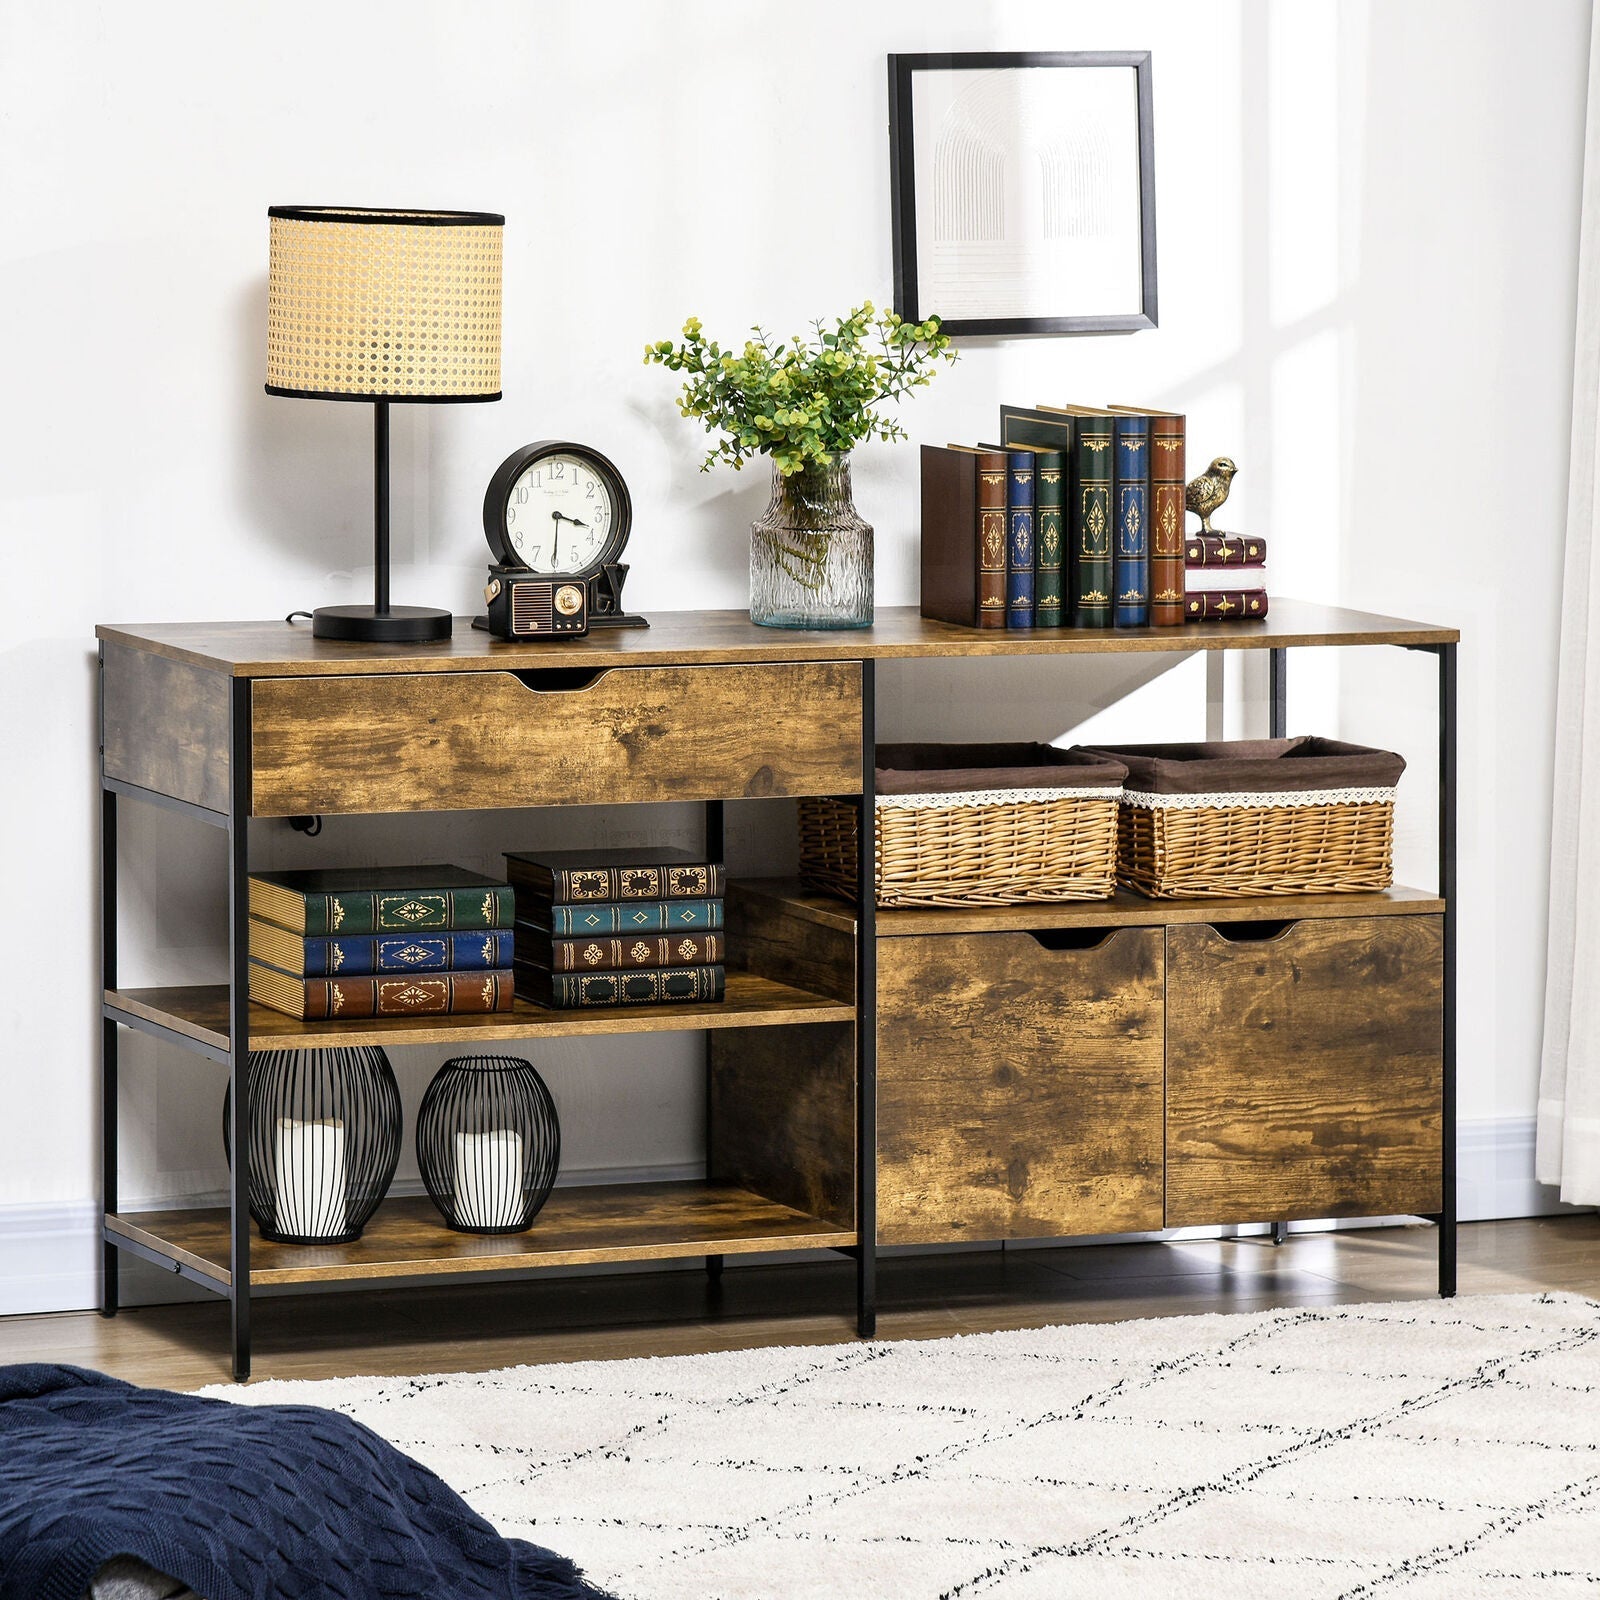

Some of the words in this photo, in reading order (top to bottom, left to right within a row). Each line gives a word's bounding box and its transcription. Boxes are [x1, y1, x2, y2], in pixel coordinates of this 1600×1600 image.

[528, 470, 542, 488] 11
[548, 462, 565, 480] 12
[572, 468, 579, 486] 1
[514, 487, 529, 505] 10
[586, 481, 595, 499] 2
[507, 507, 516, 525] 9
[594, 505, 603, 523] 3
[515, 531, 524, 549] 8
[586, 528, 595, 546] 4
[531, 545, 541, 563] 7
[570, 545, 579, 563] 5
